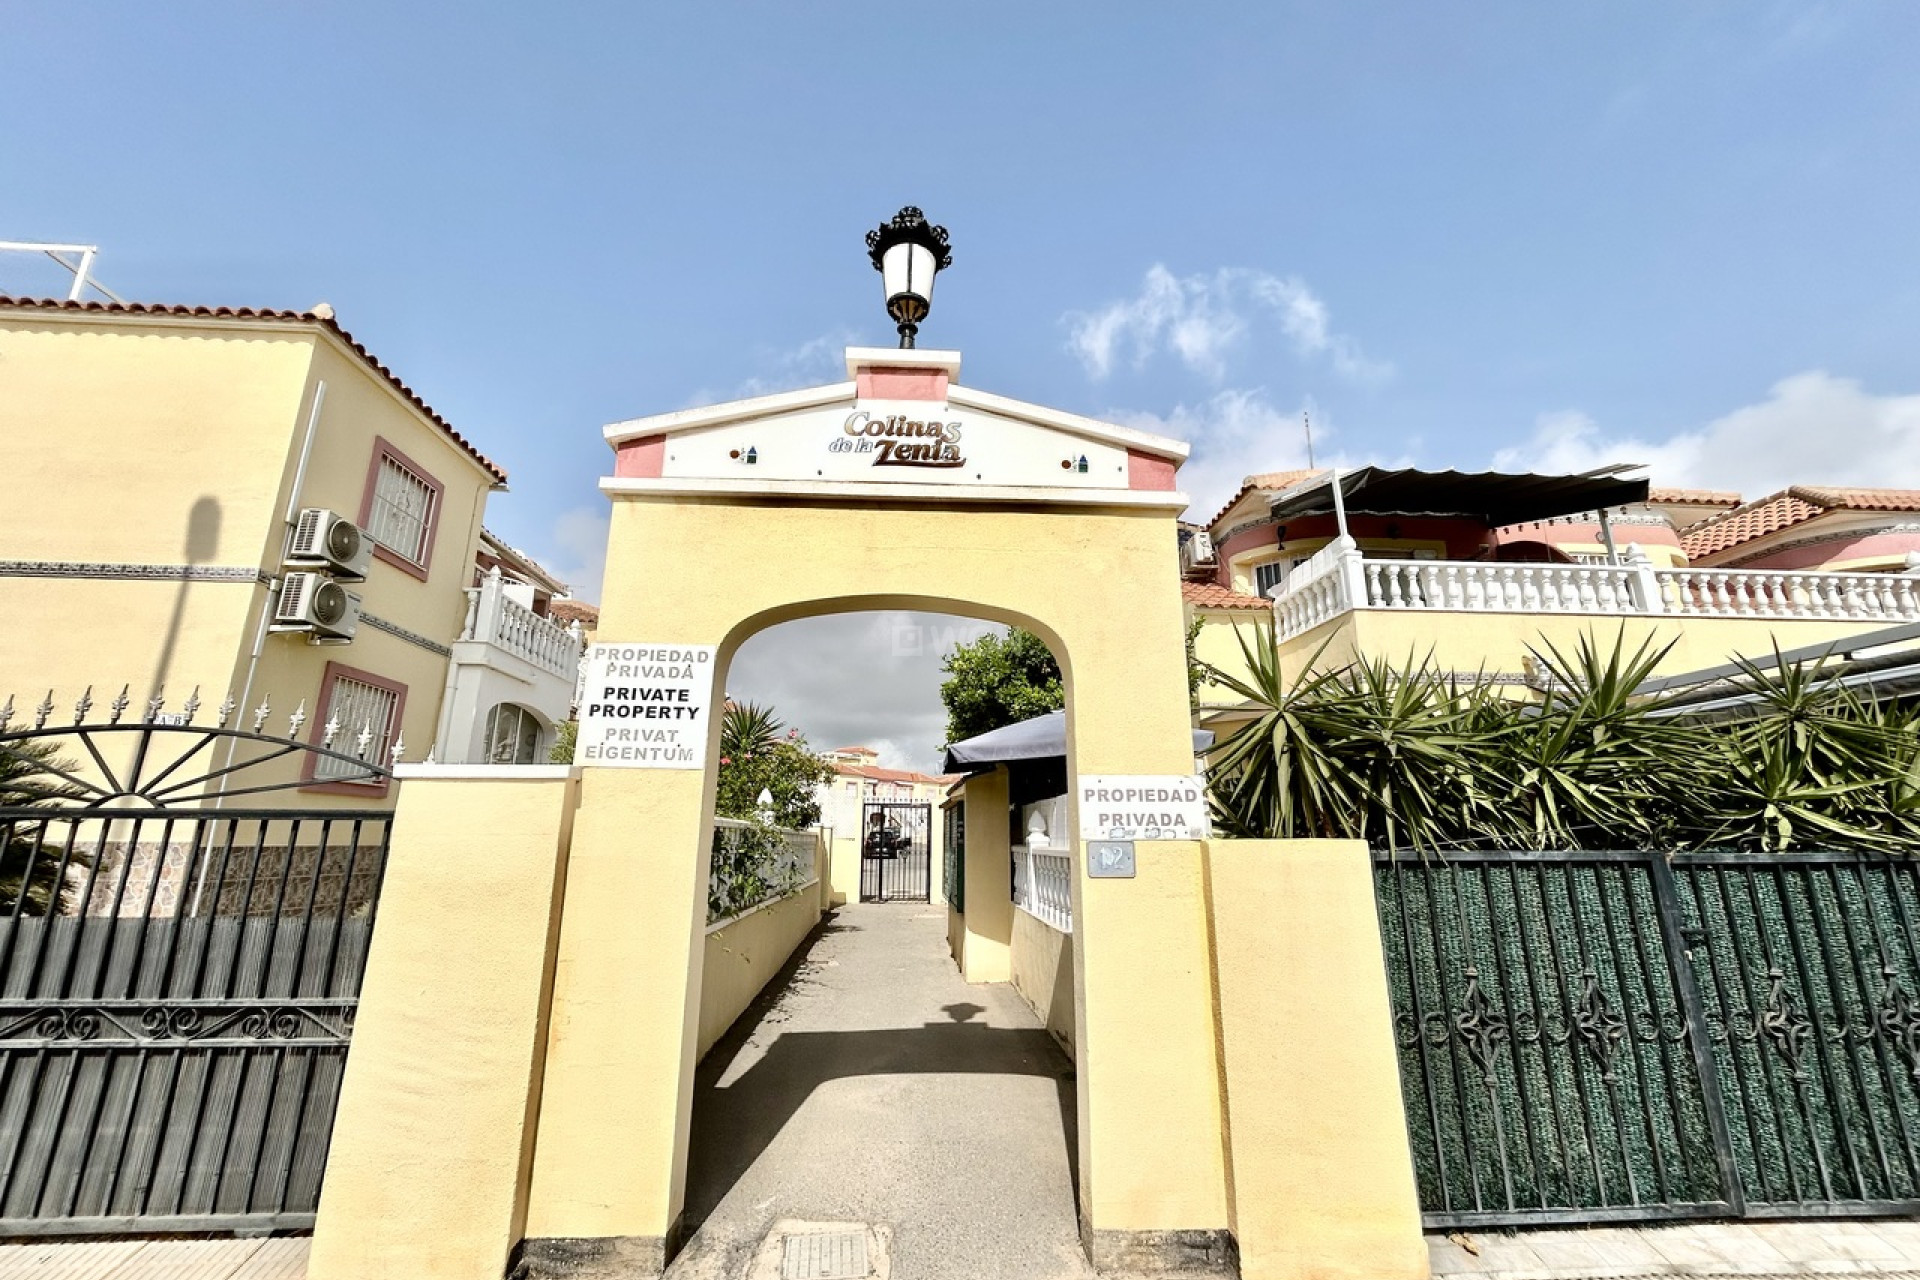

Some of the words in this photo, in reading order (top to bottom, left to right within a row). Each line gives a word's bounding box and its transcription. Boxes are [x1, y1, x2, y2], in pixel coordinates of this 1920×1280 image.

[844, 411, 962, 443] Colinas
[828, 437, 852, 453] de
[855, 438, 873, 453] la
[872, 437, 966, 468] Zenia
[594, 648, 709, 663] PROPIEDAD
[605, 664, 694, 679] PRIVADA
[603, 687, 690, 702] PRIVATE
[588, 704, 700, 720] PROPERTY
[605, 728, 679, 743] PRIVAT
[585, 745, 693, 761] EIGENTUM
[1084, 789, 1197, 803] PROPIEDAD
[1098, 813, 1187, 827] PRIVADA
